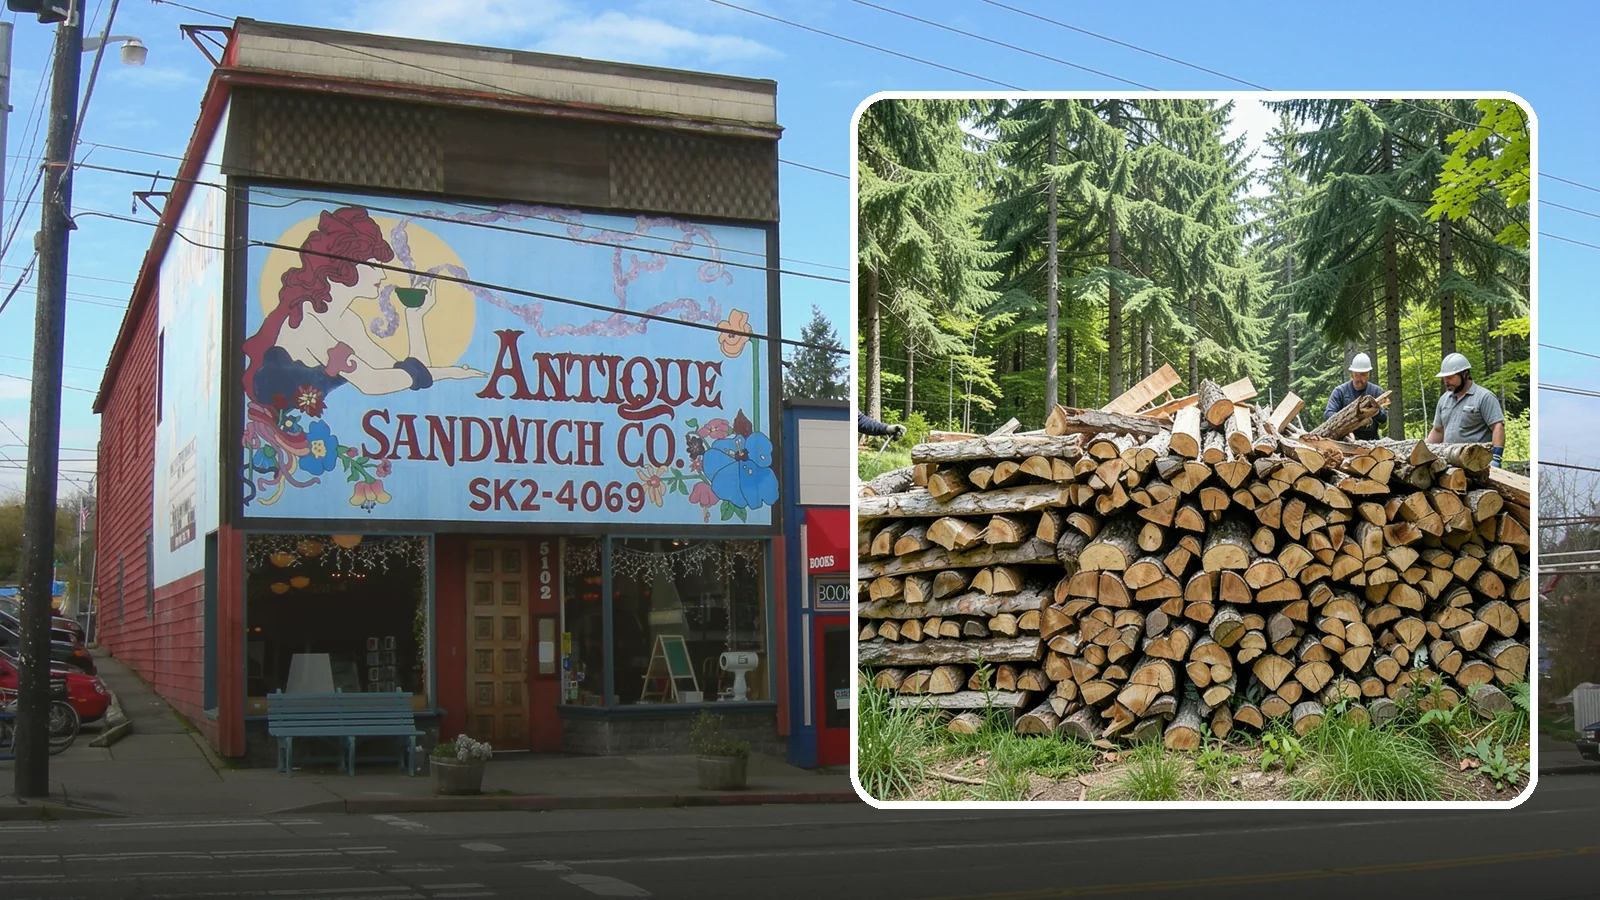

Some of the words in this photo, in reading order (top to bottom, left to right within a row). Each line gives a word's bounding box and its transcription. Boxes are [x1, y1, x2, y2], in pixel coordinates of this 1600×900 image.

[476, 329, 724, 421] ANTIQUE
[361, 408, 604, 467] SANDWICH
[617, 422, 684, 469] CO.
[468, 477, 645, 513] SK2-4069
[540, 541, 552, 599] 5102
[809, 555, 835, 569] BOOKS
